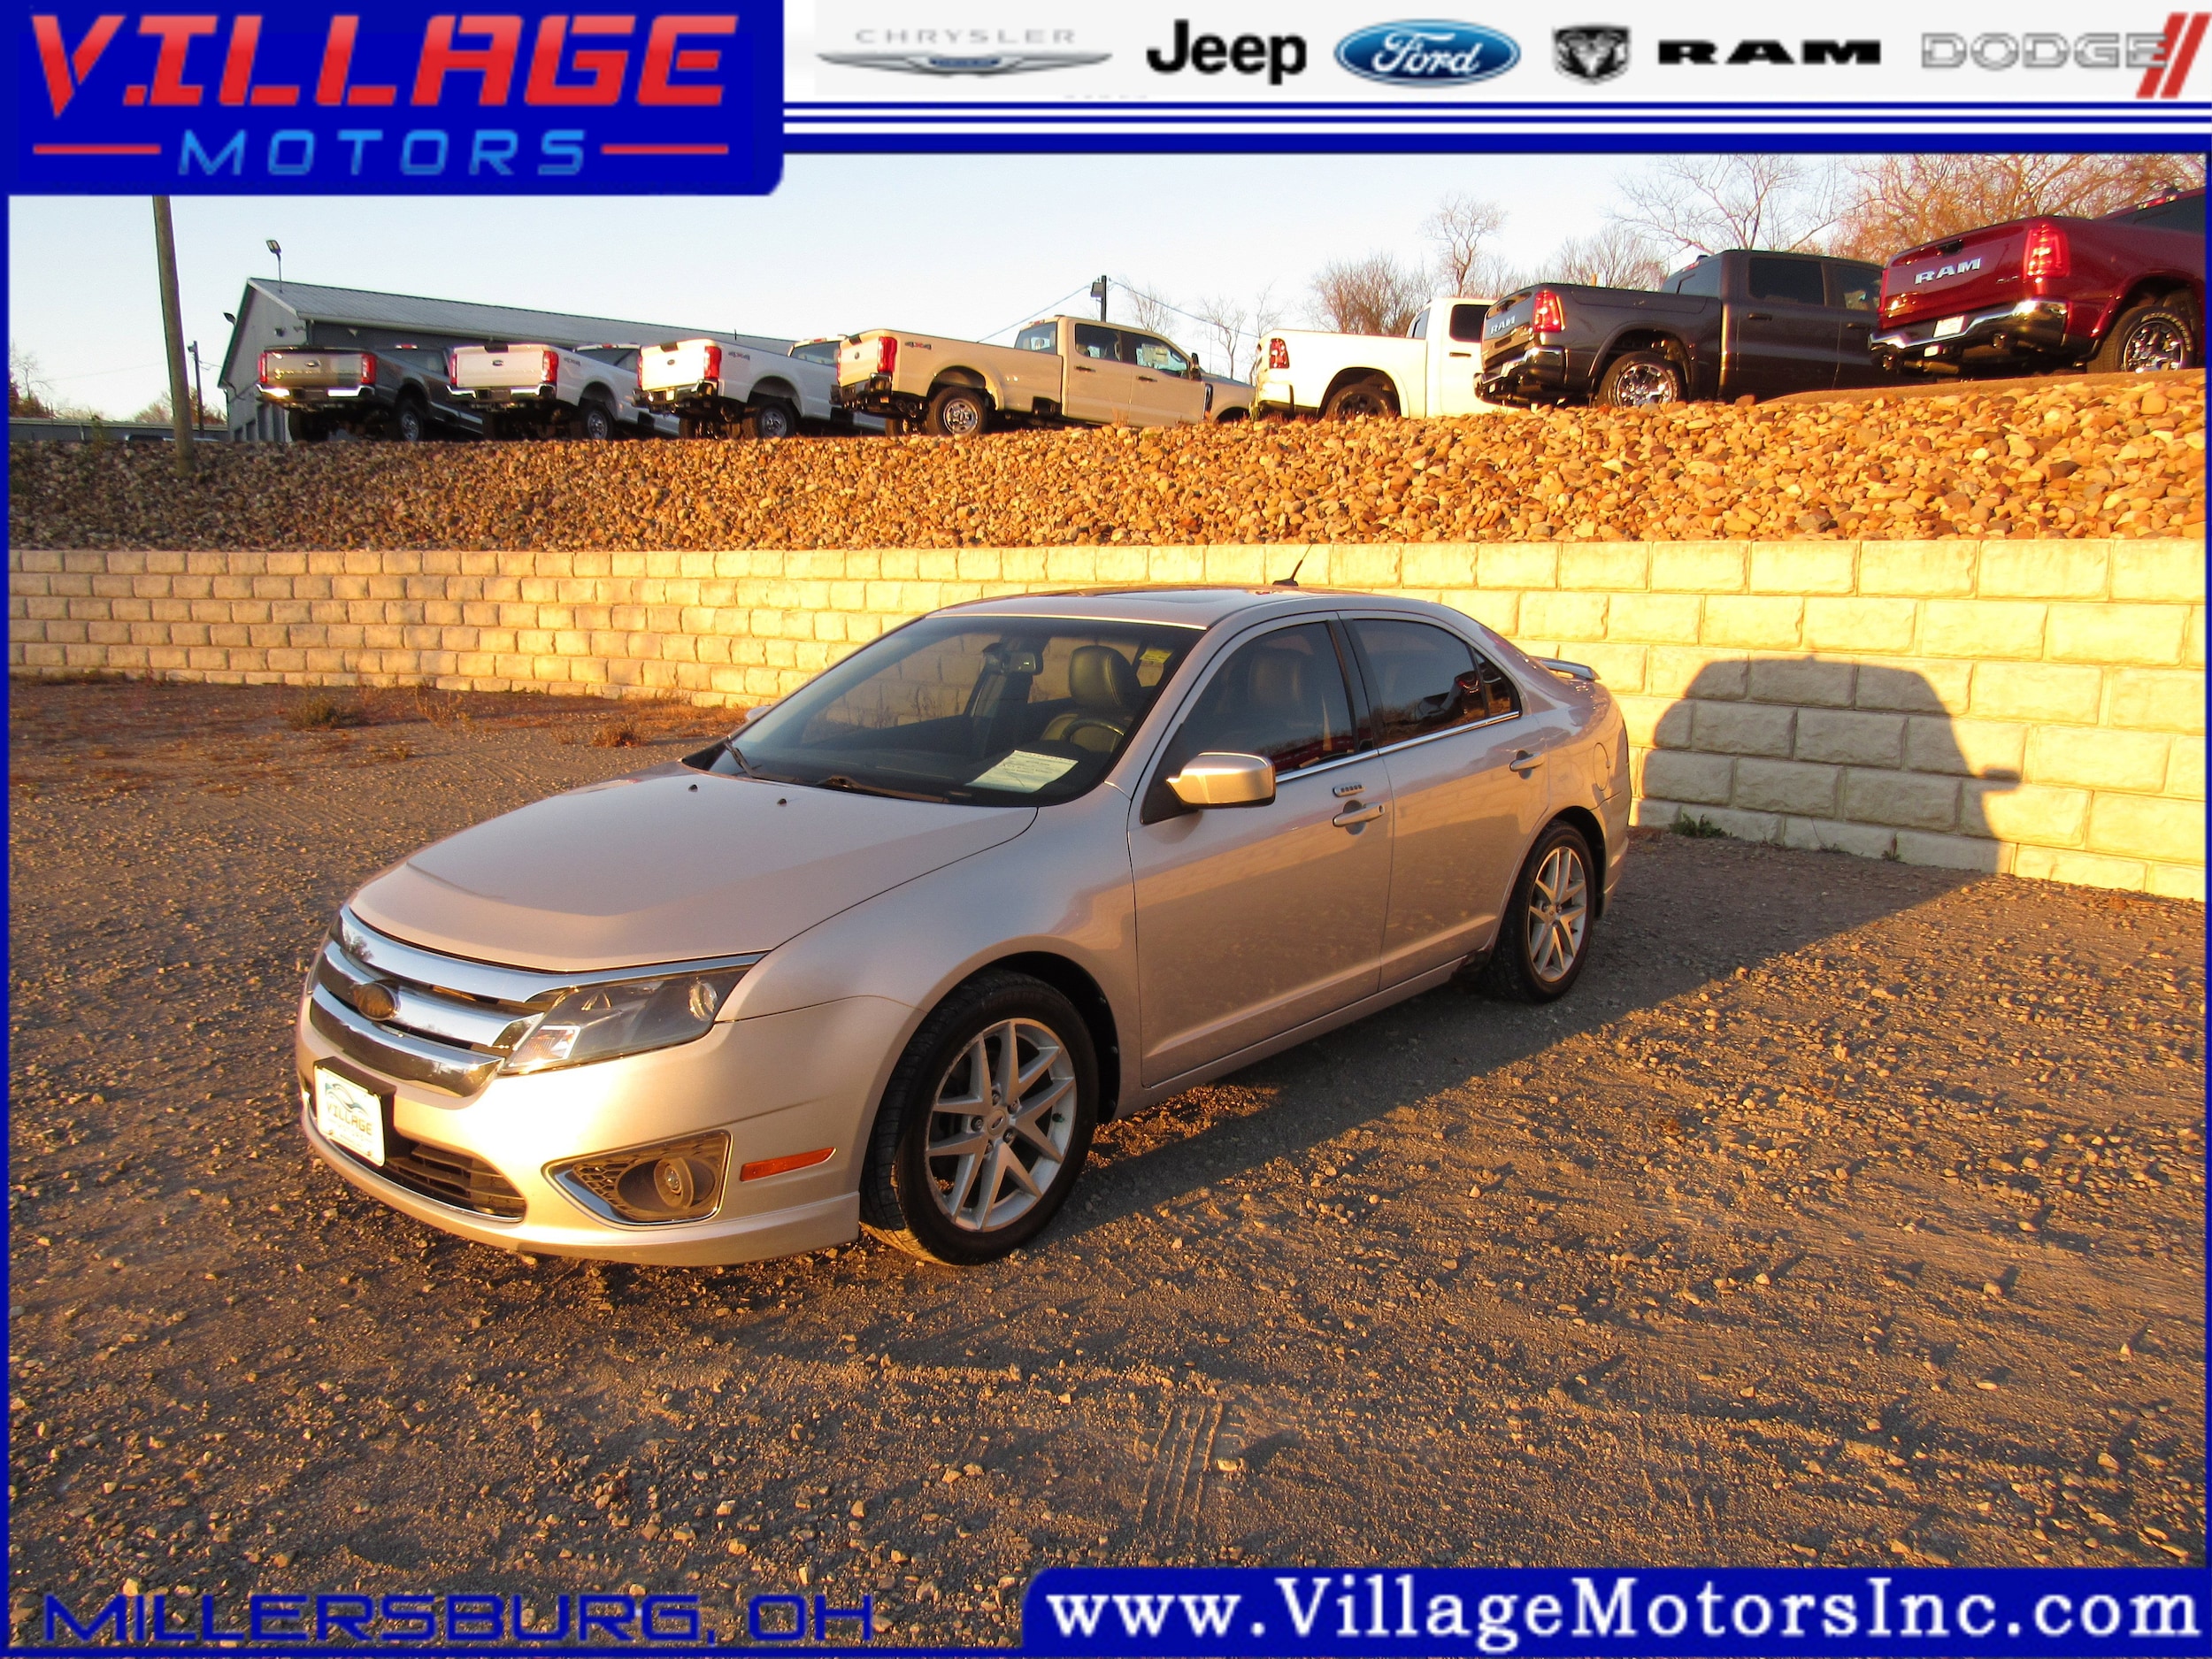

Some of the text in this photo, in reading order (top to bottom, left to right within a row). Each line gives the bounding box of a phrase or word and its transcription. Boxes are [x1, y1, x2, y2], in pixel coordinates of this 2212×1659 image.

[1915, 257, 1982, 285] RAM
[1489, 315, 1516, 335] RAM
[326, 1102, 373, 1136] VILLAGE
